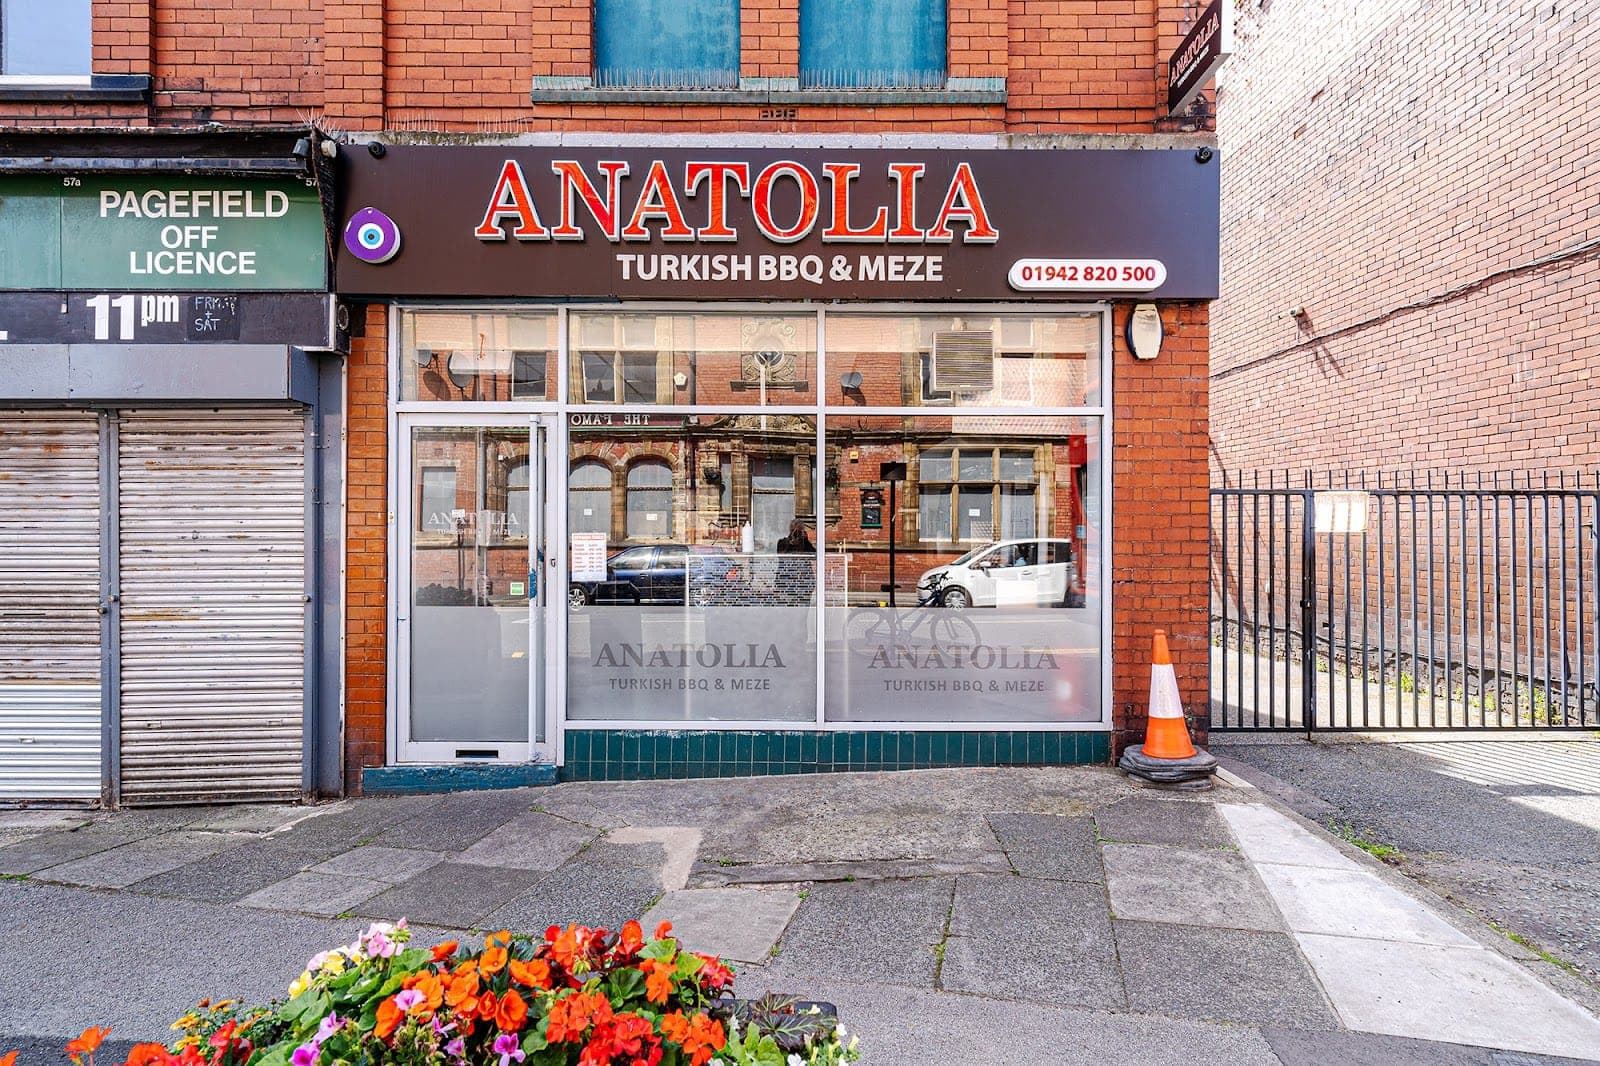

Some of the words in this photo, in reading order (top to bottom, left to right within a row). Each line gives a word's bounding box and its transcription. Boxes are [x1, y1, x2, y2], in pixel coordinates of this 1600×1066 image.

[1169, 12, 1220, 88] ANATOLIA
[62, 177, 81, 187] 57a
[99, 190, 289, 218] PAGEFIELD
[475, 159, 999, 243] ANATOLIA
[160, 225, 219, 249] OFF
[129, 251, 256, 275] LICENCE
[616, 253, 753, 281] TURKISH
[759, 253, 824, 285] BBQ
[828, 254, 854, 282] &
[858, 254, 943, 282] MEZE
[1022, 266, 1079, 281] 01942
[1083, 266, 1118, 281] 820
[1122, 266, 1156, 281] 500
[194, 318, 221, 331] SAT
[428, 512, 520, 525] ANATLIA
[592, 642, 787, 668] ANATOLIA
[867, 644, 1061, 670] ANATOLIA
[609, 678, 673, 690] TURKISH
[678, 678, 710, 692] BBQ
[714, 678, 725, 690] &
[731, 678, 771, 690] MEZE
[884, 680, 947, 692] TURKISH
[952, 680, 984, 693] BBQ
[988, 680, 1000, 692] &
[1005, 680, 1045, 692] MEZE
